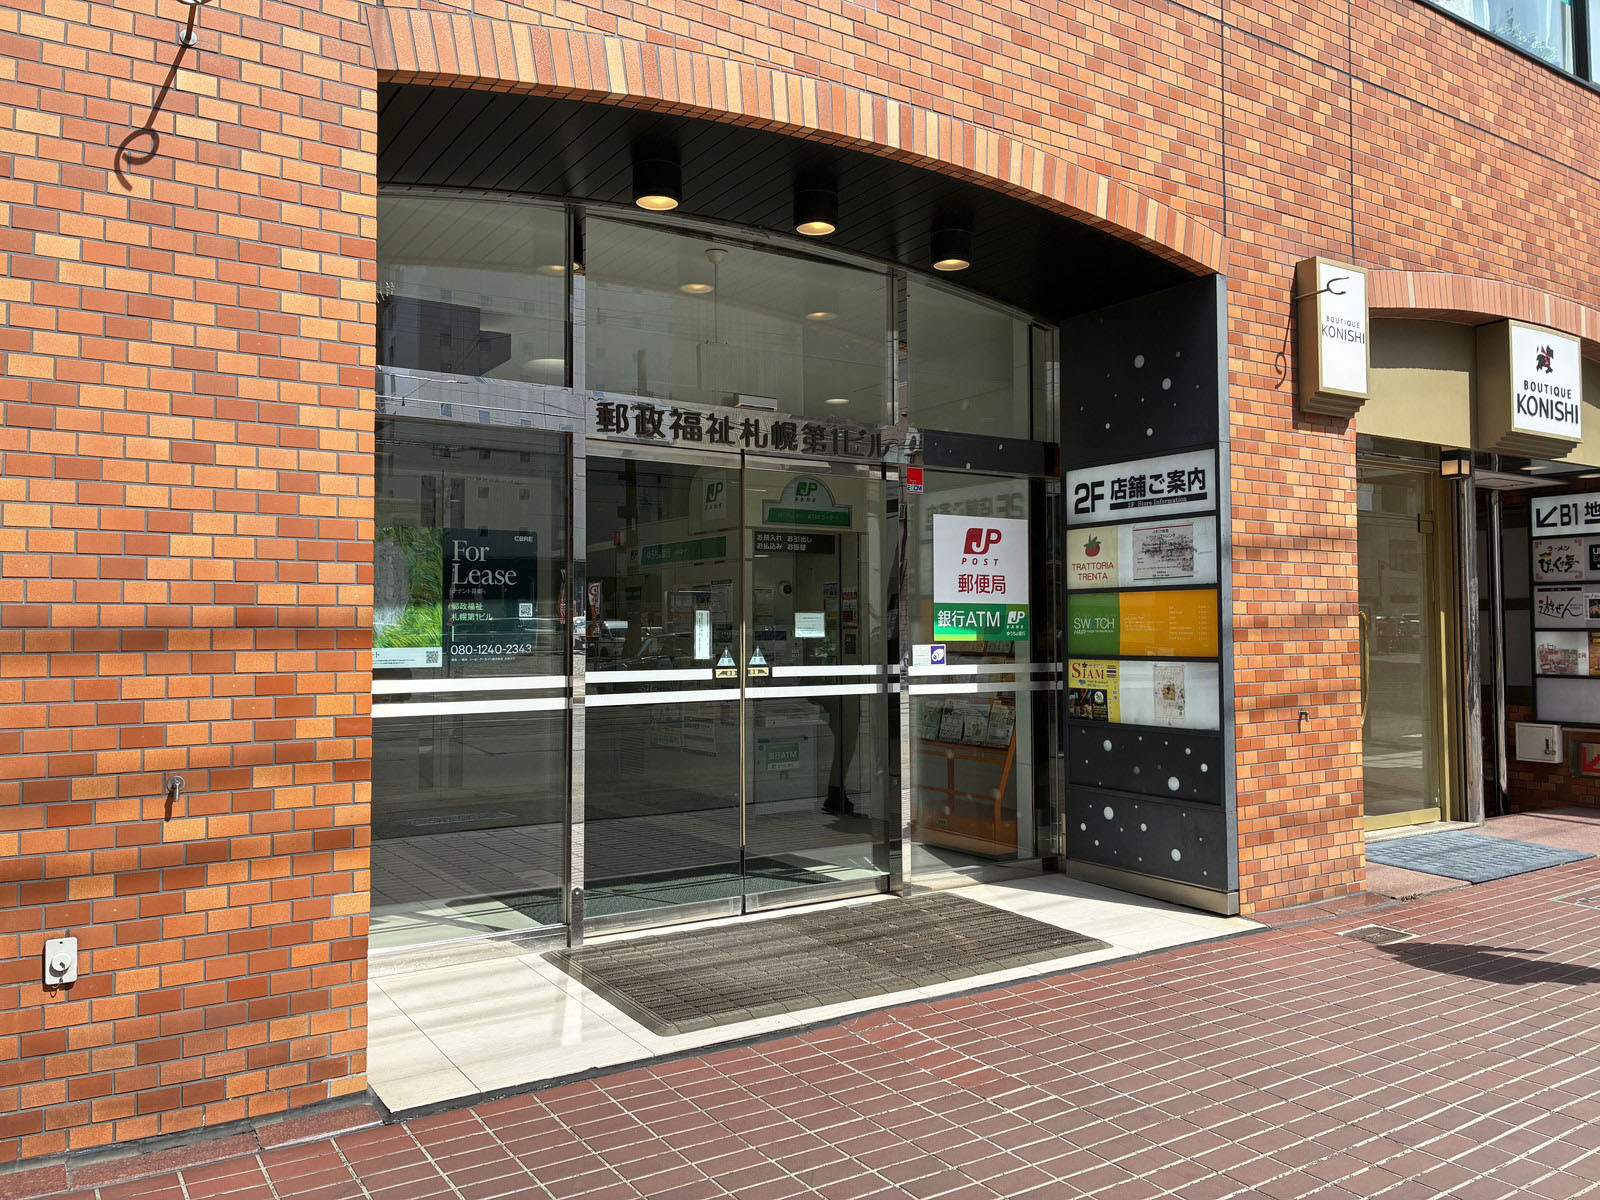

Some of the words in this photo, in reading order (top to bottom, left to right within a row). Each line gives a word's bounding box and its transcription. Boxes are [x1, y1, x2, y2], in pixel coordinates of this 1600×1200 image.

[1326, 315, 1361, 329] BOUTIQUE
[1321, 323, 1365, 344] KONISHI
[1523, 380, 1572, 399] BOUTIQUE
[1516, 393, 1579, 425] KONISHI
[1074, 480, 1105, 514] 2F
[1109, 467, 1206, 501] 店舗ご案内
[1153, 497, 1187, 506] Information
[1560, 503, 1578, 526] B1
[451, 539, 490, 562] For
[963, 528, 1002, 555] JP
[961, 557, 1000, 566] POST
[1071, 561, 1114, 571] TRATTORIA
[451, 563, 517, 586] Lease
[1077, 572, 1108, 581] TRENTA
[957, 573, 1007, 595] 郵便局
[451, 602, 484, 611] 郵政福祉
[451, 613, 493, 622] 札幌第1ビル
[937, 610, 1000, 628] 銀行ATM
[1007, 611, 1025, 624] JP
[450, 644, 532, 656] 080-1240-2343
[1071, 662, 1104, 680] SIAM
